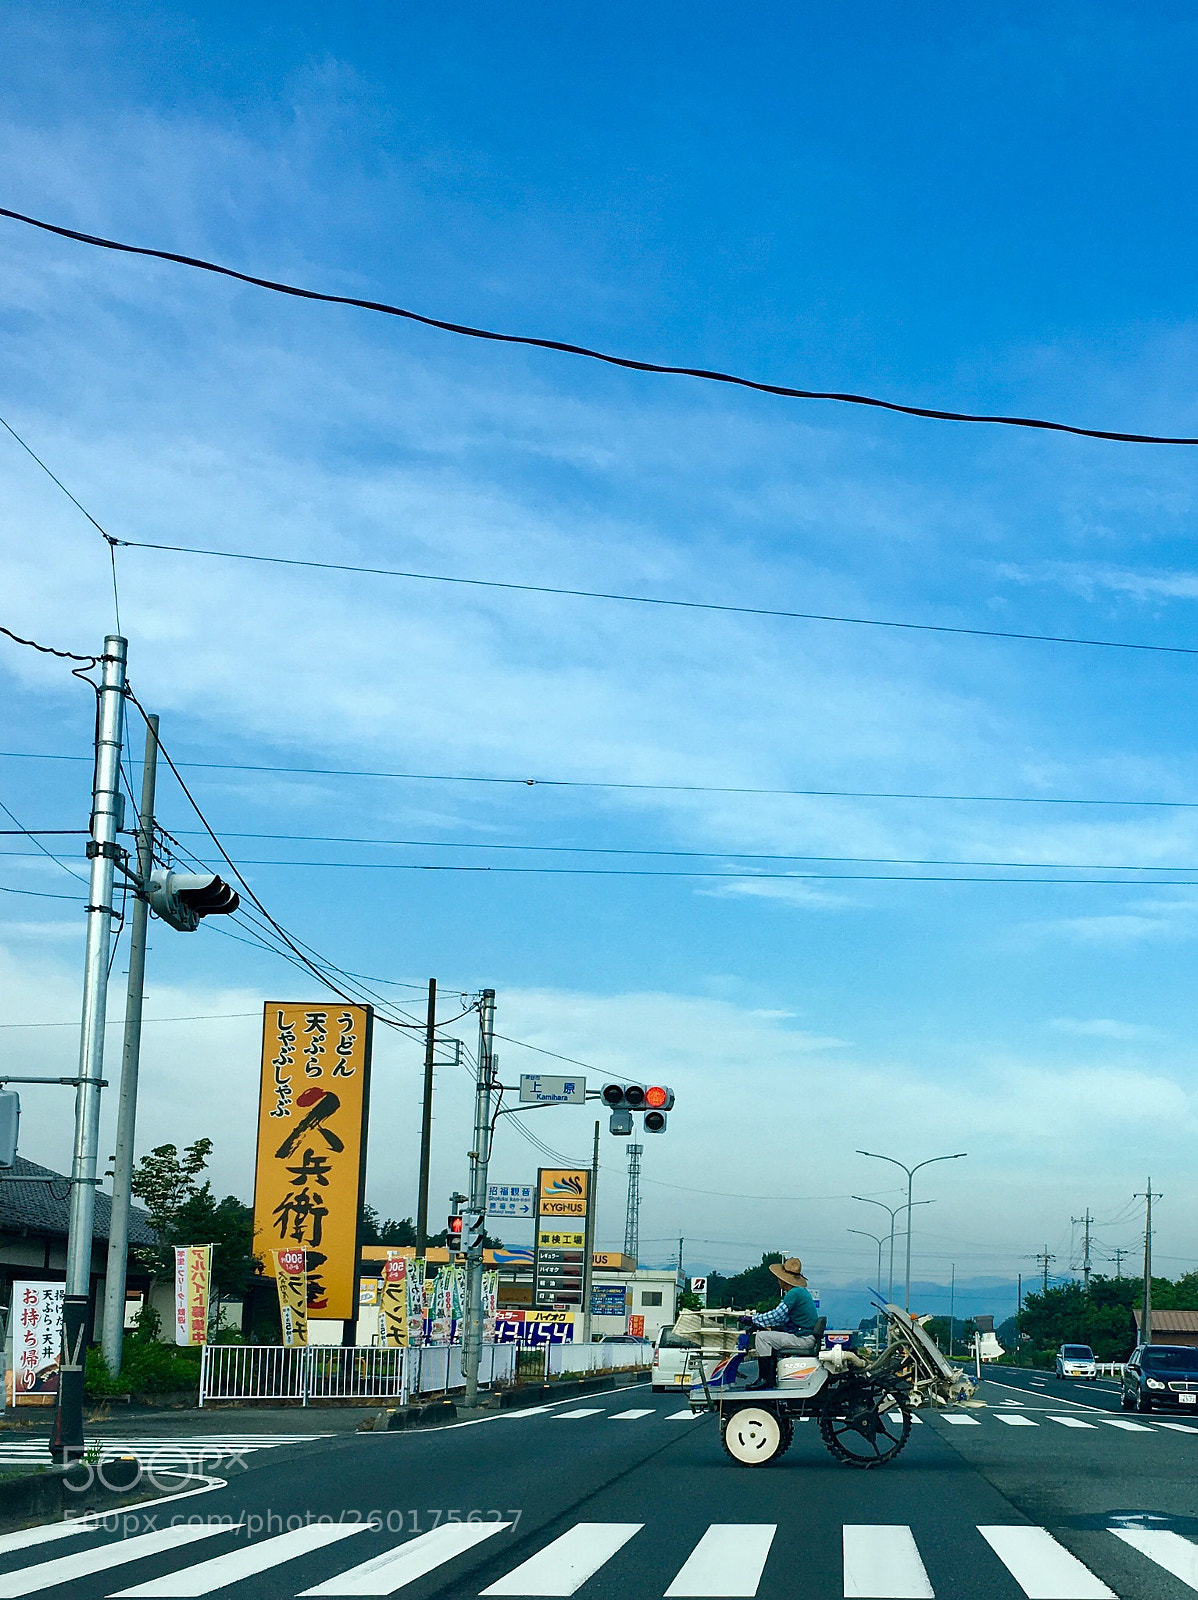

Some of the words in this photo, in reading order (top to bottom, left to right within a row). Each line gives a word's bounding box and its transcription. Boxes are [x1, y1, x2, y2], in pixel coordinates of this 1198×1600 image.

[269, 1009, 297, 1118] しゃぶしゃぶ
[302, 1012, 329, 1079] 天ぷら
[332, 1011, 357, 1078] うどん
[536, 1093, 568, 1101] Kamihara
[542, 1203, 583, 1213] KYGNUS
[541, 1234, 583, 1244] 車検工場
[535, 1312, 567, 1322] ハイオク
[20, 1287, 40, 1391] お持ち帰り
